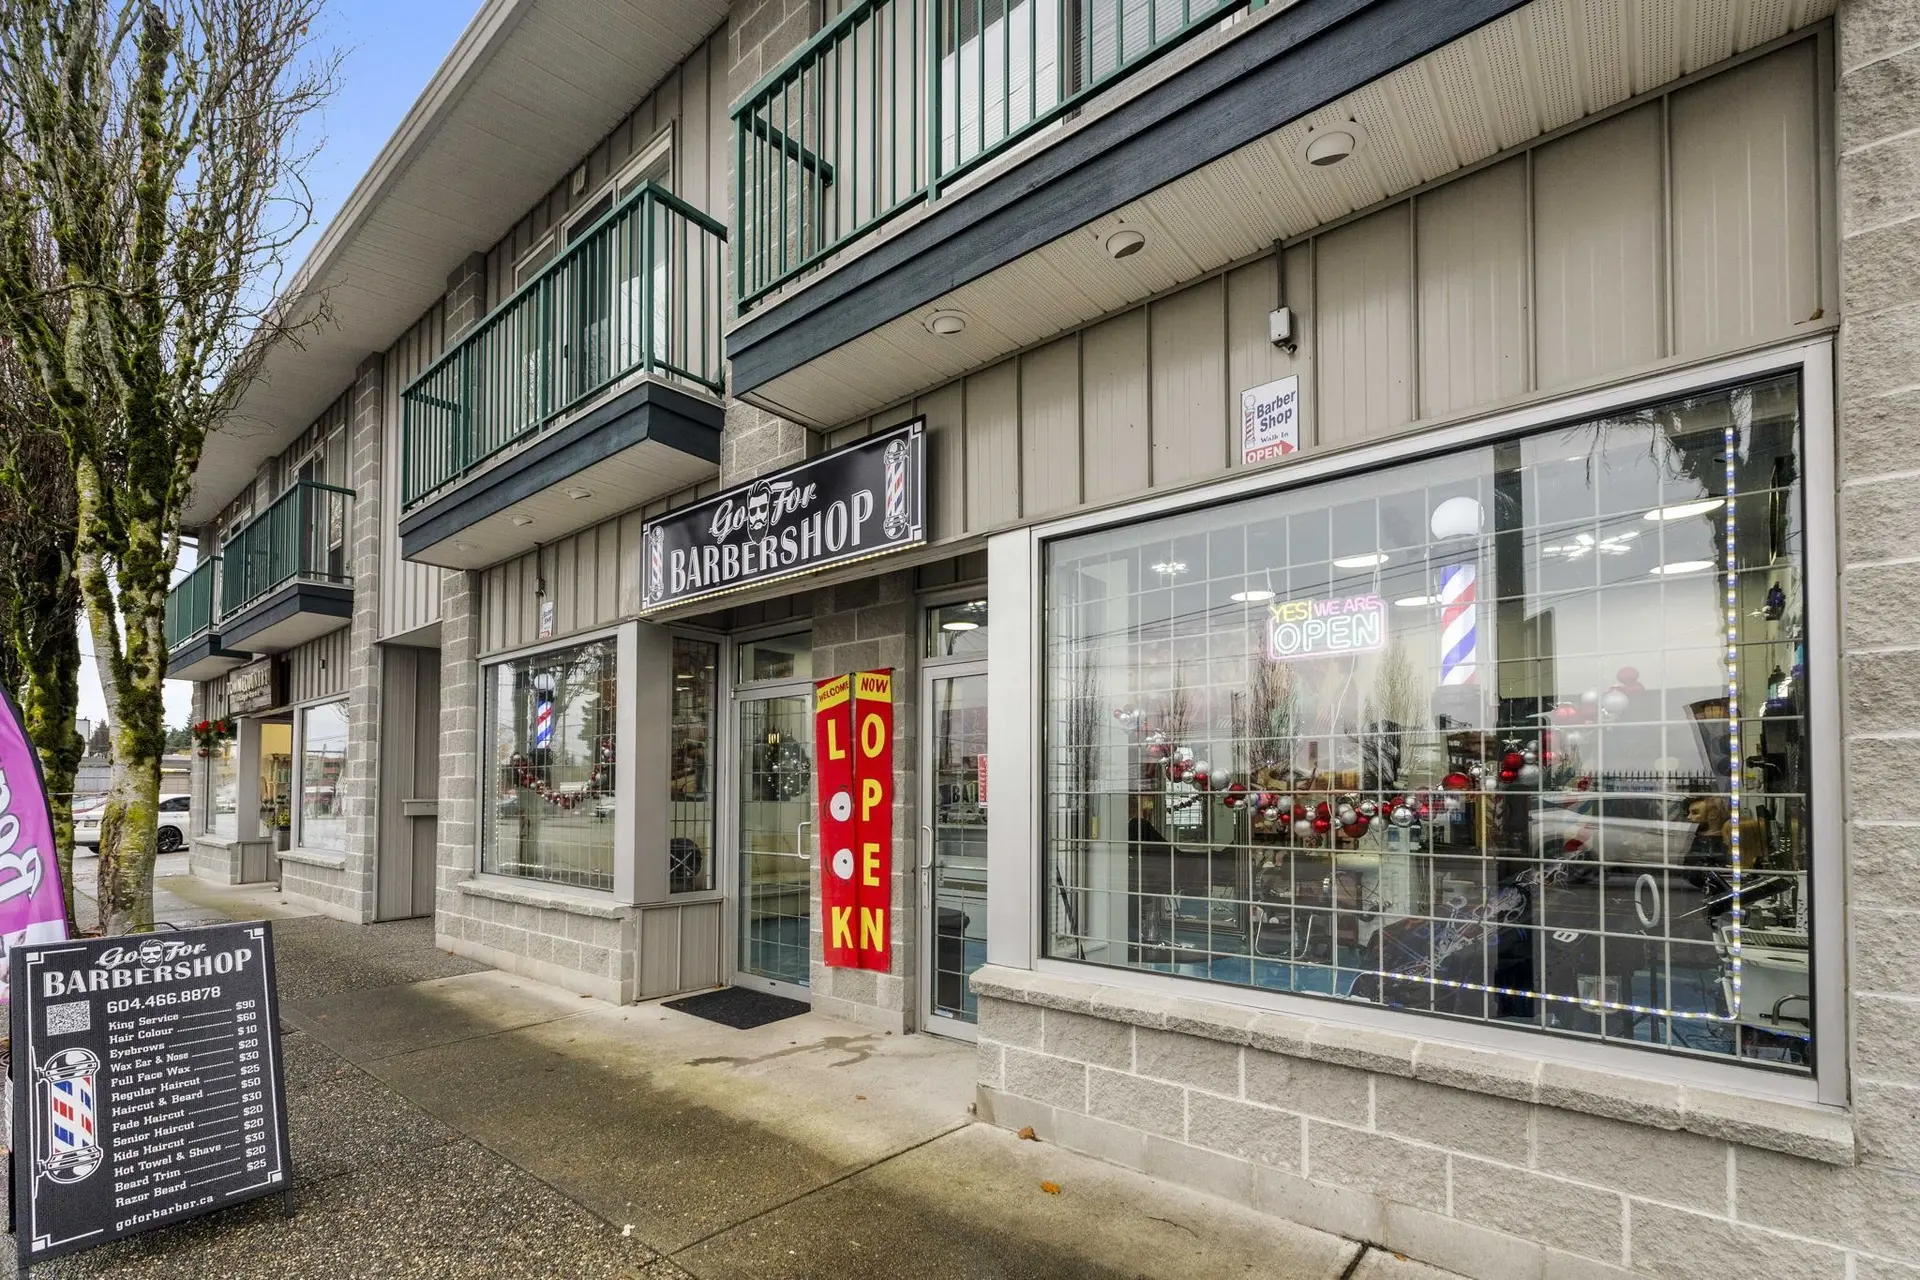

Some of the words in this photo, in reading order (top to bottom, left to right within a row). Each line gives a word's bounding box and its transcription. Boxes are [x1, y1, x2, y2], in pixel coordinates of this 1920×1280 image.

[1257, 390, 1296, 419] Barber
[1260, 407, 1293, 432] Shop
[1247, 444, 1283, 463] OPEN
[1260, 435, 1279, 443] Walk
[1281, 430, 1289, 438] In
[708, 499, 748, 544] Go
[770, 480, 817, 525] For
[670, 488, 874, 594] BARBERSHOP
[1313, 600, 1339, 616] WE
[1343, 595, 1378, 613] ARE
[1274, 611, 1379, 654] OPEN
[819, 681, 850, 702] WELCOME
[861, 677, 888, 693] NOW
[860, 713, 885, 952] OPEN
[43, 949, 251, 997] BARBERSHOP
[95, 947, 138, 970] Go
[164, 941, 207, 961] For
[107, 986, 221, 1014] 604.466.8878
[108, 1019, 134, 1031] King
[139, 1013, 179, 1026] Service
[235, 999, 256, 1010] $90
[109, 1033, 134, 1044] Hair
[138, 1027, 174, 1039] Colour
[236, 1012, 257, 1023] $60
[110, 1043, 165, 1059] Eyebrows
[238, 1024, 258, 1035] $10
[111, 1063, 132, 1073] Wax
[135, 1059, 152, 1069] Ear
[155, 1055, 164, 1064] &
[166, 1052, 189, 1062] Nose
[238, 1038, 259, 1050] $20
[111, 1075, 133, 1087] Full
[138, 1071, 163, 1083] Face
[167, 1066, 190, 1076] Wax
[239, 1051, 260, 1062] $30
[111, 1086, 156, 1102] Regular
[160, 1076, 201, 1092] Haircut
[240, 1064, 261, 1075] $25
[112, 1101, 155, 1117] Haircut
[159, 1097, 167, 1106] &
[172, 1090, 204, 1104] Beard
[241, 1077, 262, 1088] $50
[112, 1119, 140, 1132] Fade
[144, 1109, 186, 1125] Haircut
[242, 1091, 263, 1103] $30
[113, 1133, 150, 1147] Senior
[154, 1121, 195, 1138] Haircut
[243, 1104, 264, 1116] $20
[113, 1149, 139, 1162] Kids
[143, 1138, 185, 1155] Haircut
[244, 1118, 265, 1130] $20
[114, 1164, 135, 1177] Hot
[138, 1155, 172, 1171] Towel
[176, 1151, 185, 1161] &
[189, 1144, 222, 1158] Shave
[245, 1131, 266, 1144] $30
[115, 1176, 150, 1193] Beard
[153, 1169, 181, 1182] Trim
[246, 1145, 267, 1158] $20
[115, 1192, 150, 1207] Razor
[154, 1181, 187, 1197] Beard
[247, 1158, 268, 1172] $25
[115, 1195, 214, 1231] goforbarber.ca
